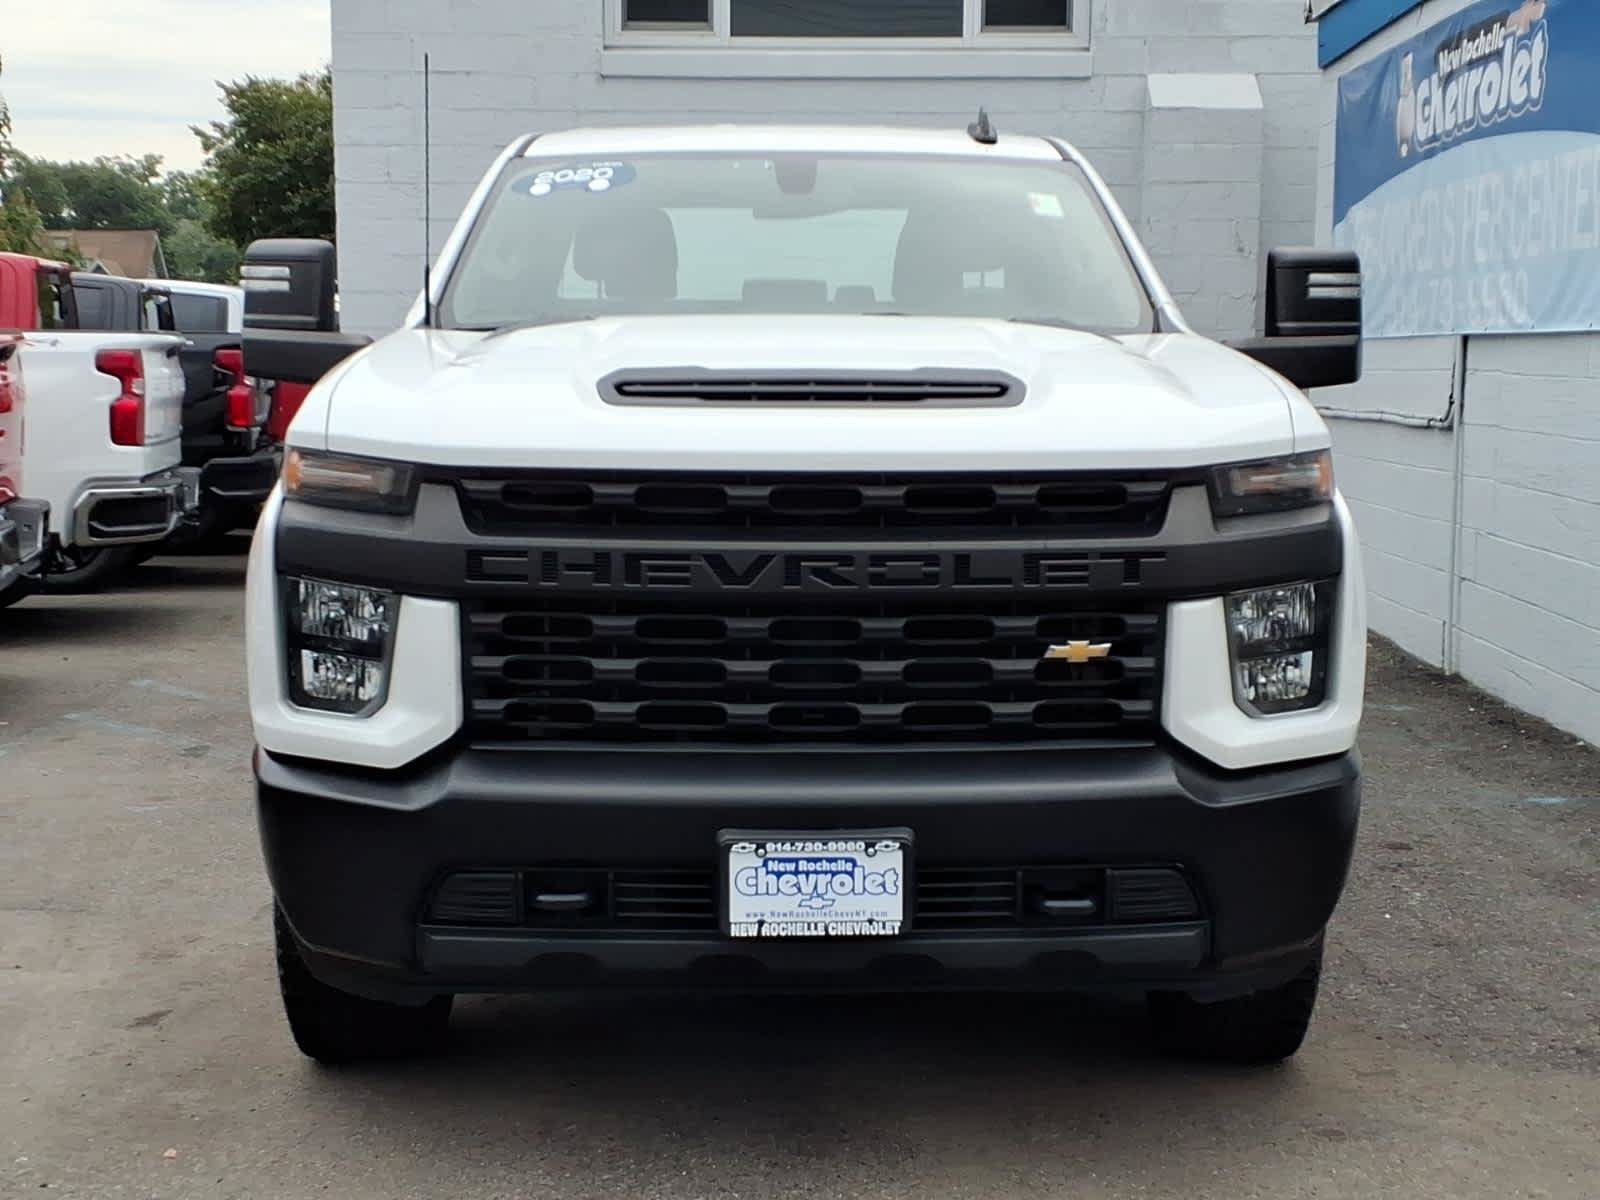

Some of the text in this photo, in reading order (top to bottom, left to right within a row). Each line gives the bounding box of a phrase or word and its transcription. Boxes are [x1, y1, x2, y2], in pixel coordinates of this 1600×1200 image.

[1415, 28, 1546, 143] Chevrolet
[464, 549, 1167, 589] CHEVROLET
[735, 864, 899, 896] Chevrolet
[767, 858, 854, 872] New Rochelle
[730, 920, 902, 937] NEW ROCHELLE CHEVROLET
